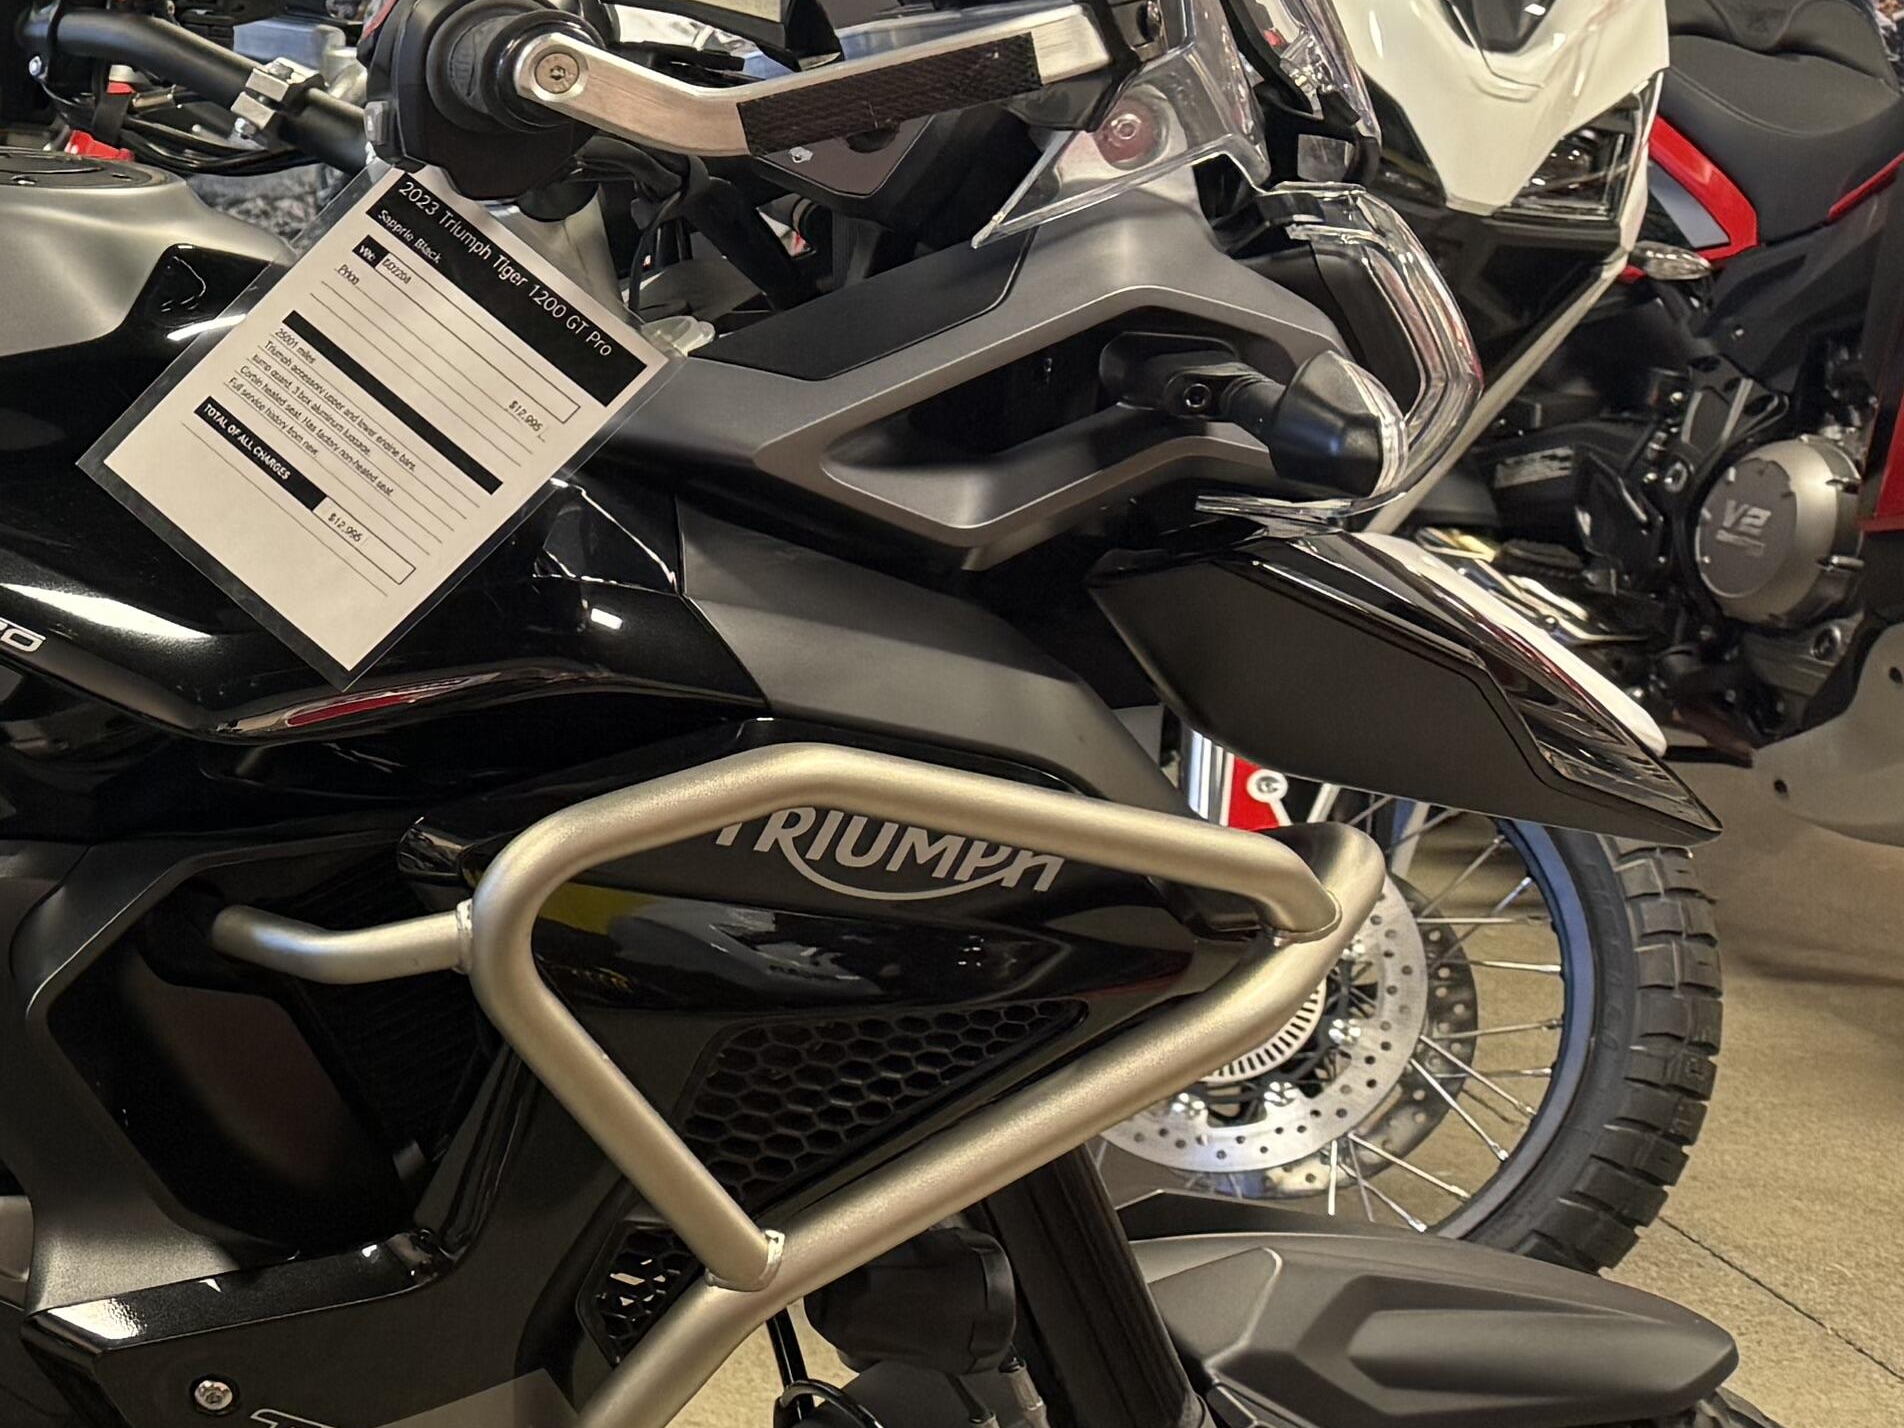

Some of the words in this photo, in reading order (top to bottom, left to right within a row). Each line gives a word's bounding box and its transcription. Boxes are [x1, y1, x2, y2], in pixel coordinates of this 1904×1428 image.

[398, 181, 439, 214] 2023
[439, 210, 493, 259] Triumph
[492, 256, 528, 286] Tiger
[528, 284, 566, 317] 1200
[566, 315, 589, 334] GT
[585, 330, 611, 355] Pro
[413, 237, 440, 263] Black
[203, 403, 227, 428] TOTAL
[227, 424, 241, 435] OF
[237, 433, 253, 450] ALL
[253, 446, 290, 479] CHARGES
[1722, 498, 1772, 536] V2
